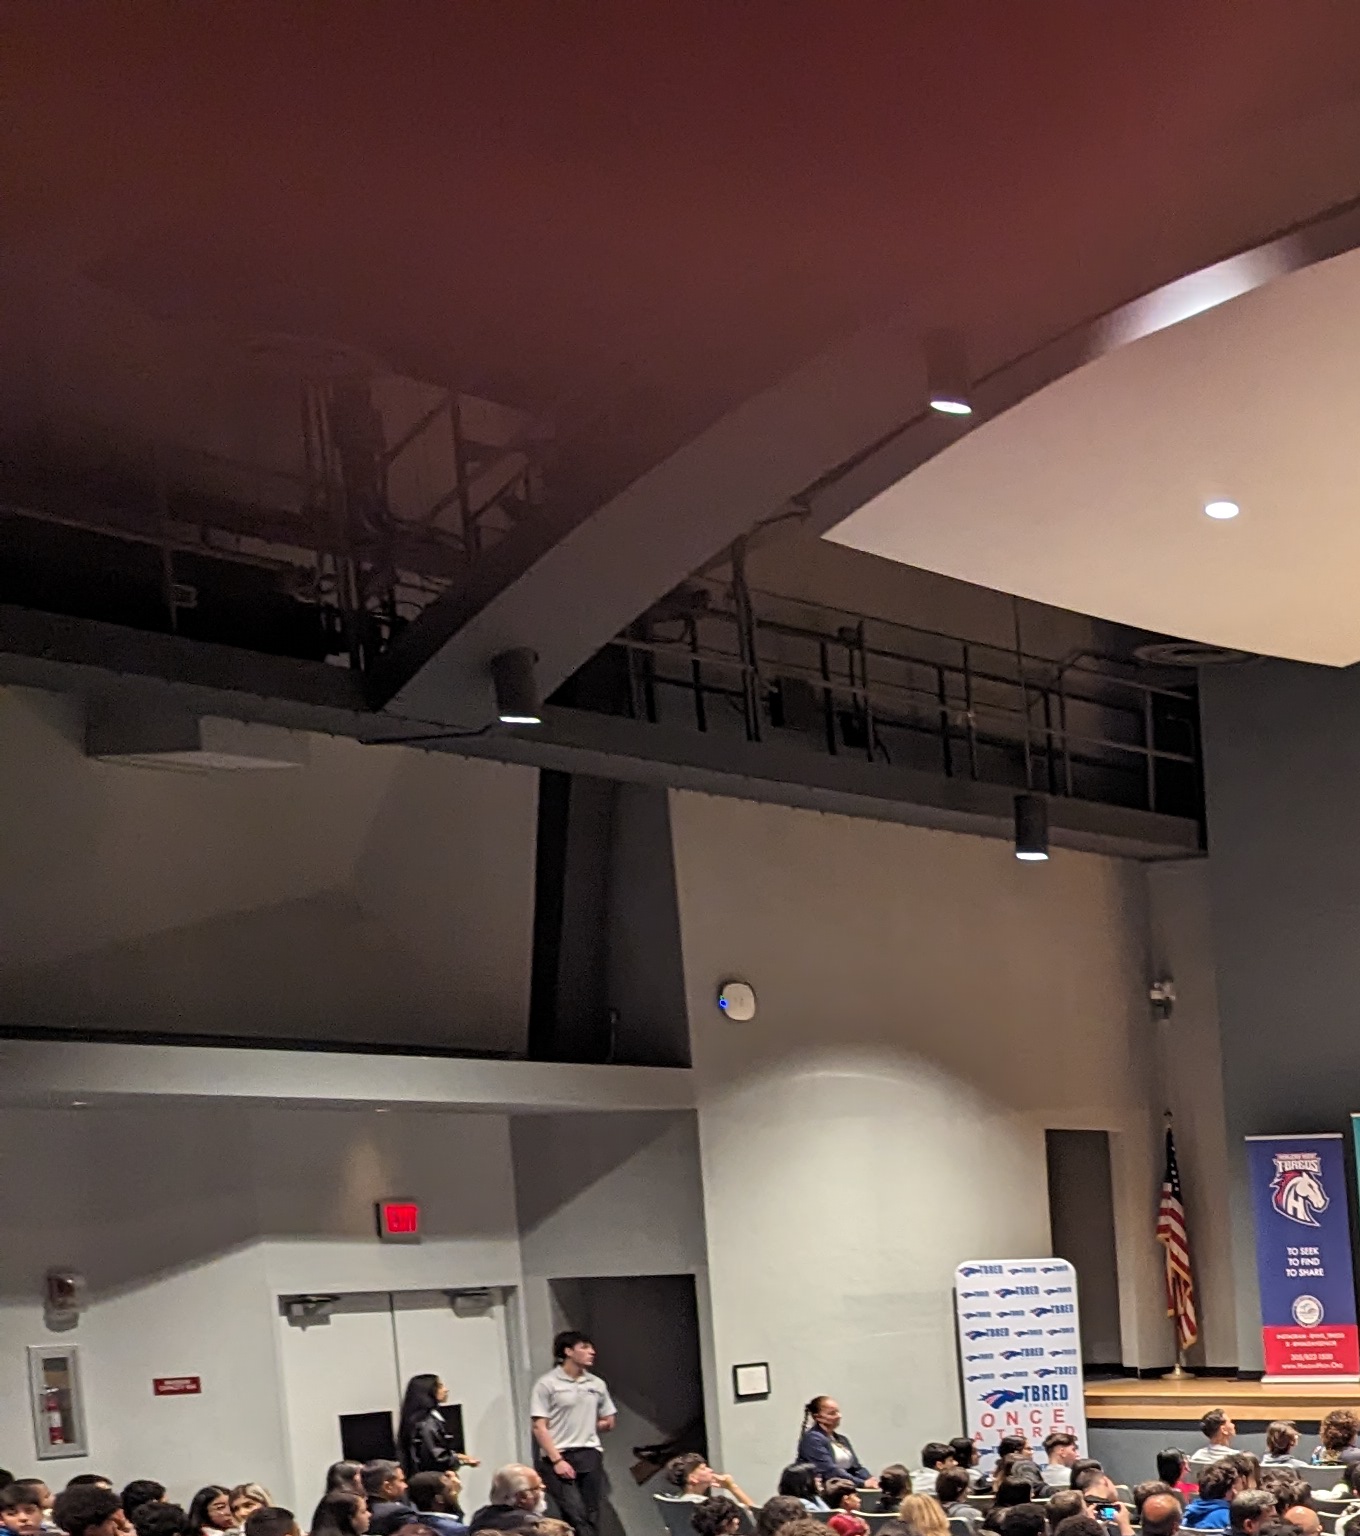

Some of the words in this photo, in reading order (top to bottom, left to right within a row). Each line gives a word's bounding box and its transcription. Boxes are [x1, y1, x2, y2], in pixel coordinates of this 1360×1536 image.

[1286, 1247, 1298, 1255] TO
[1300, 1247, 1320, 1255] SEEK
[1287, 1258, 1299, 1266] TO
[1300, 1257, 1320, 1266] FIND
[1285, 1268, 1297, 1277] TO
[1299, 1267, 1324, 1277] SHARE
[1022, 1384, 1068, 1402] TBRED
[981, 1409, 1065, 1428] ONCE
